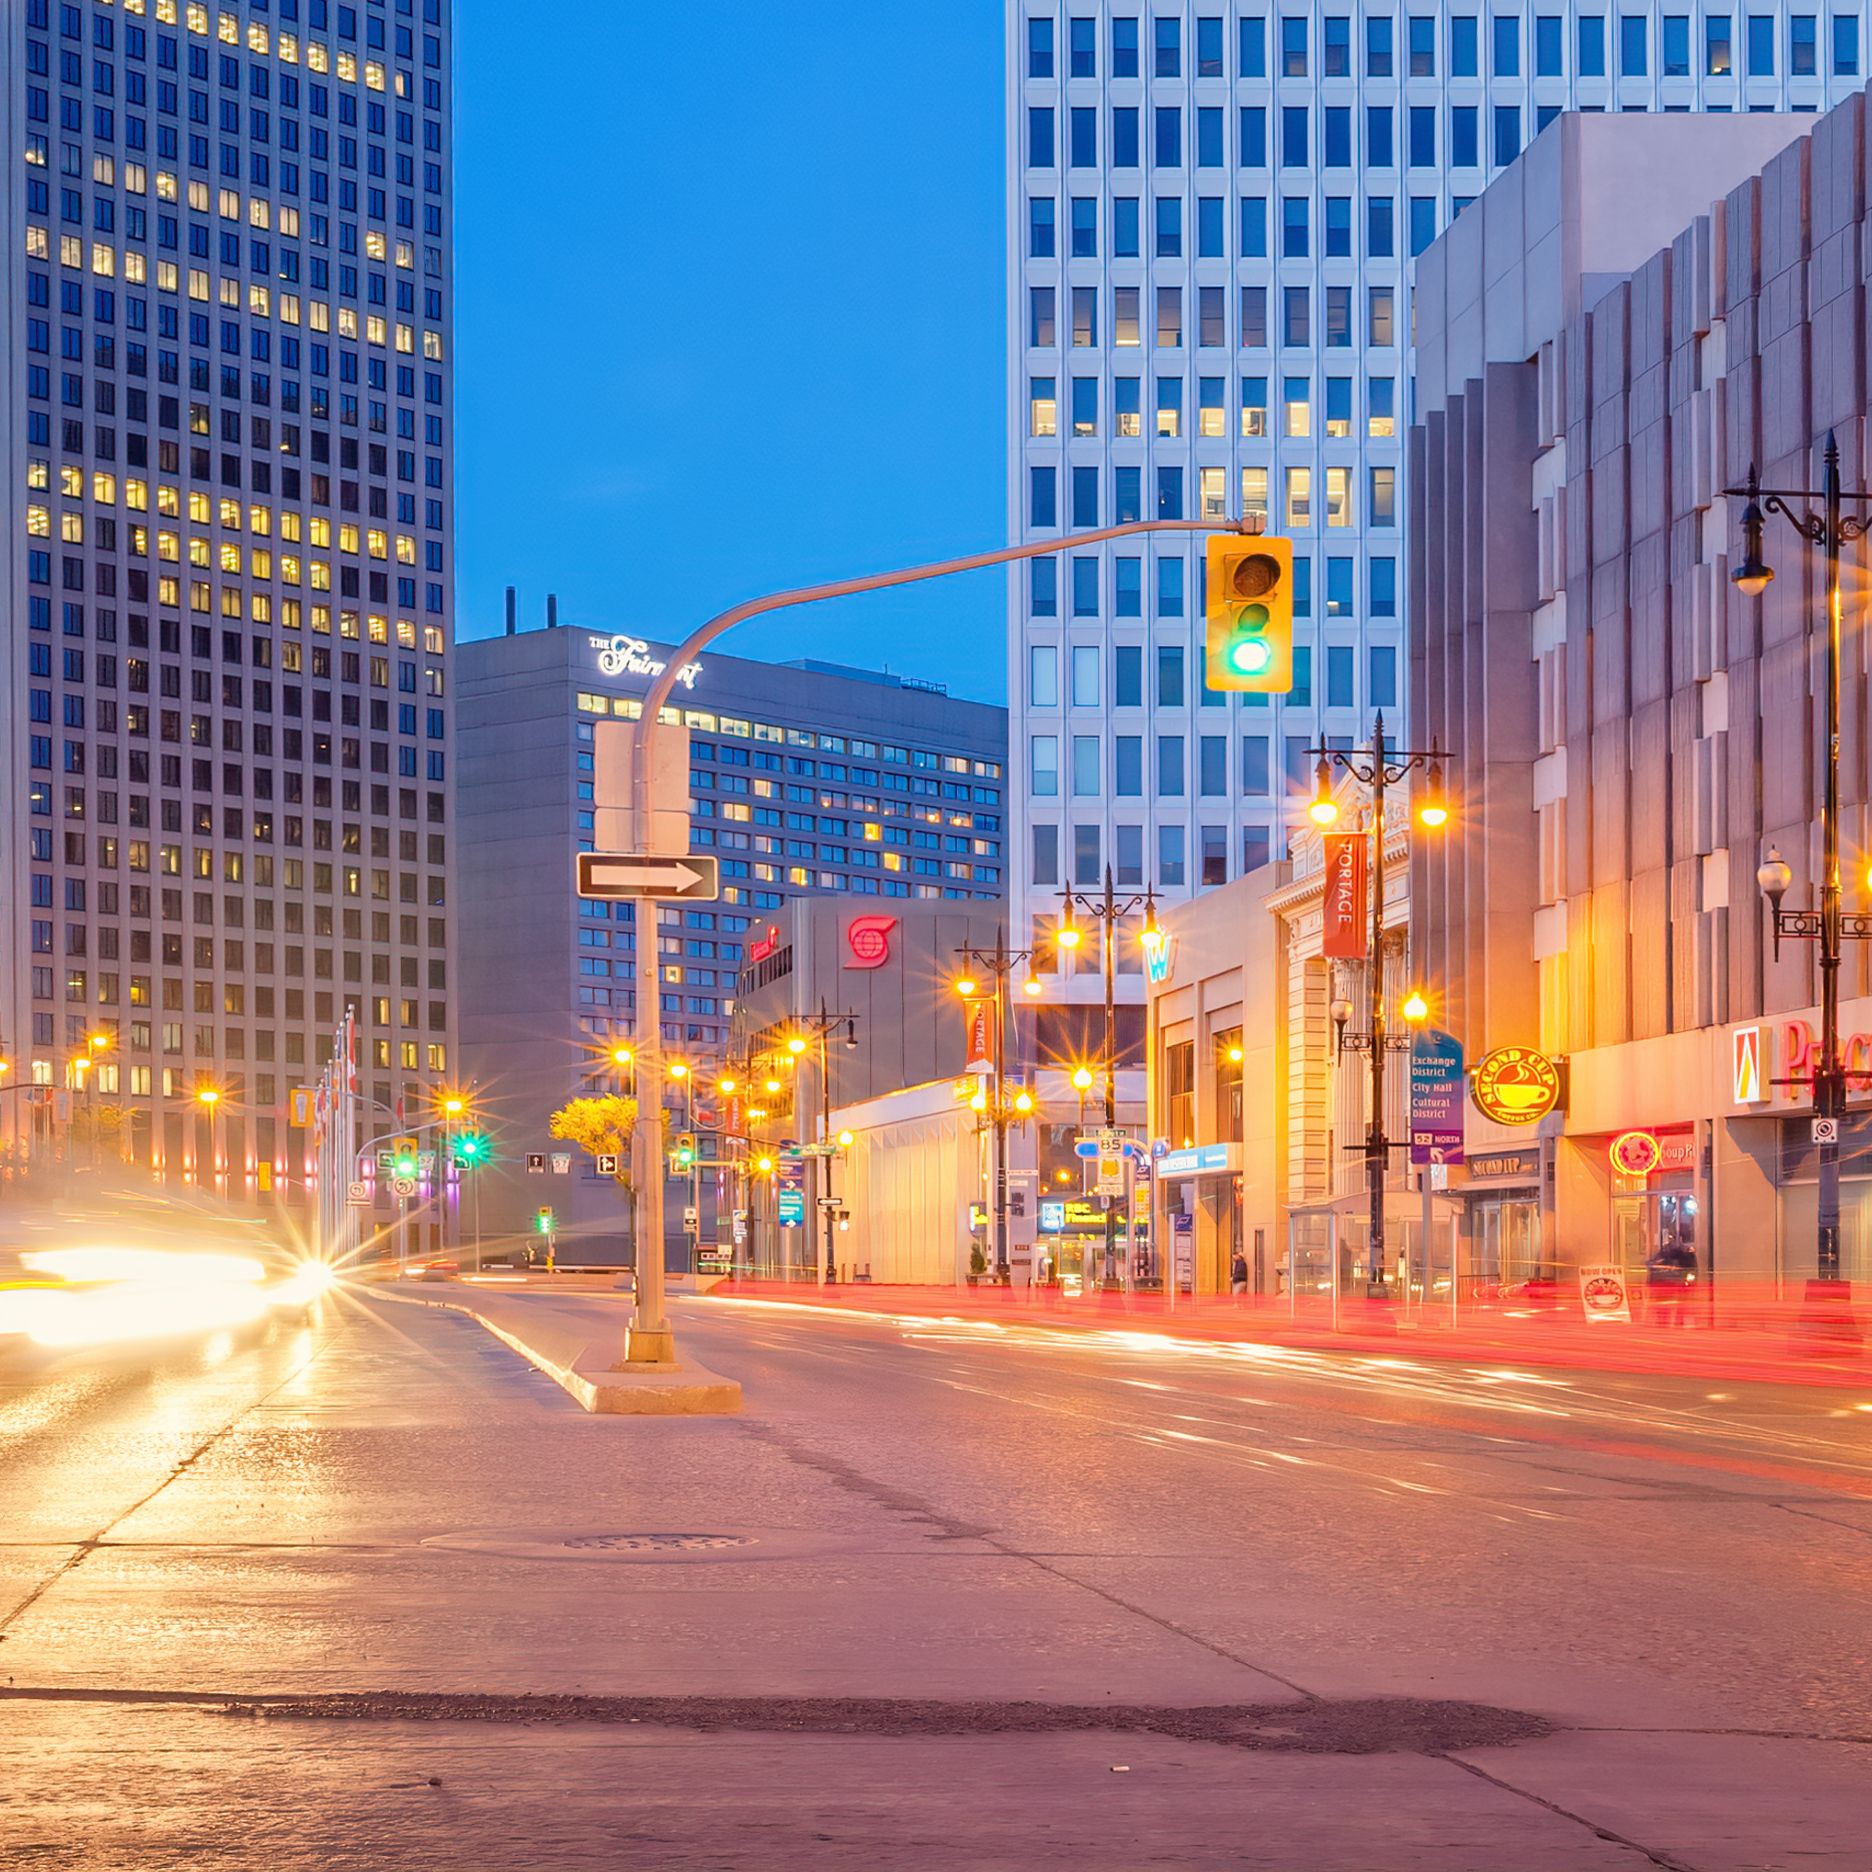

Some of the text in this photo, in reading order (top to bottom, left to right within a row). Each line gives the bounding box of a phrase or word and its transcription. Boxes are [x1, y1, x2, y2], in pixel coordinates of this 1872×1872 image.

[589, 635, 704, 690] THE Fairmnt
[1337, 843, 1354, 923] PORTAGE
[1412, 1057, 1456, 1066] Exchange
[1412, 1068, 1446, 1077] District
[1480, 1050, 1555, 1105] SECOND CUP
[1412, 1083, 1453, 1094] City Hall
[1412, 1098, 1451, 1107] Cultural
[1412, 1110, 1446, 1118] District
[1101, 1138, 1121, 1150] 85
[1416, 1135, 1460, 1143] 52 NORTH
[1064, 1203, 1091, 1214] RBC
